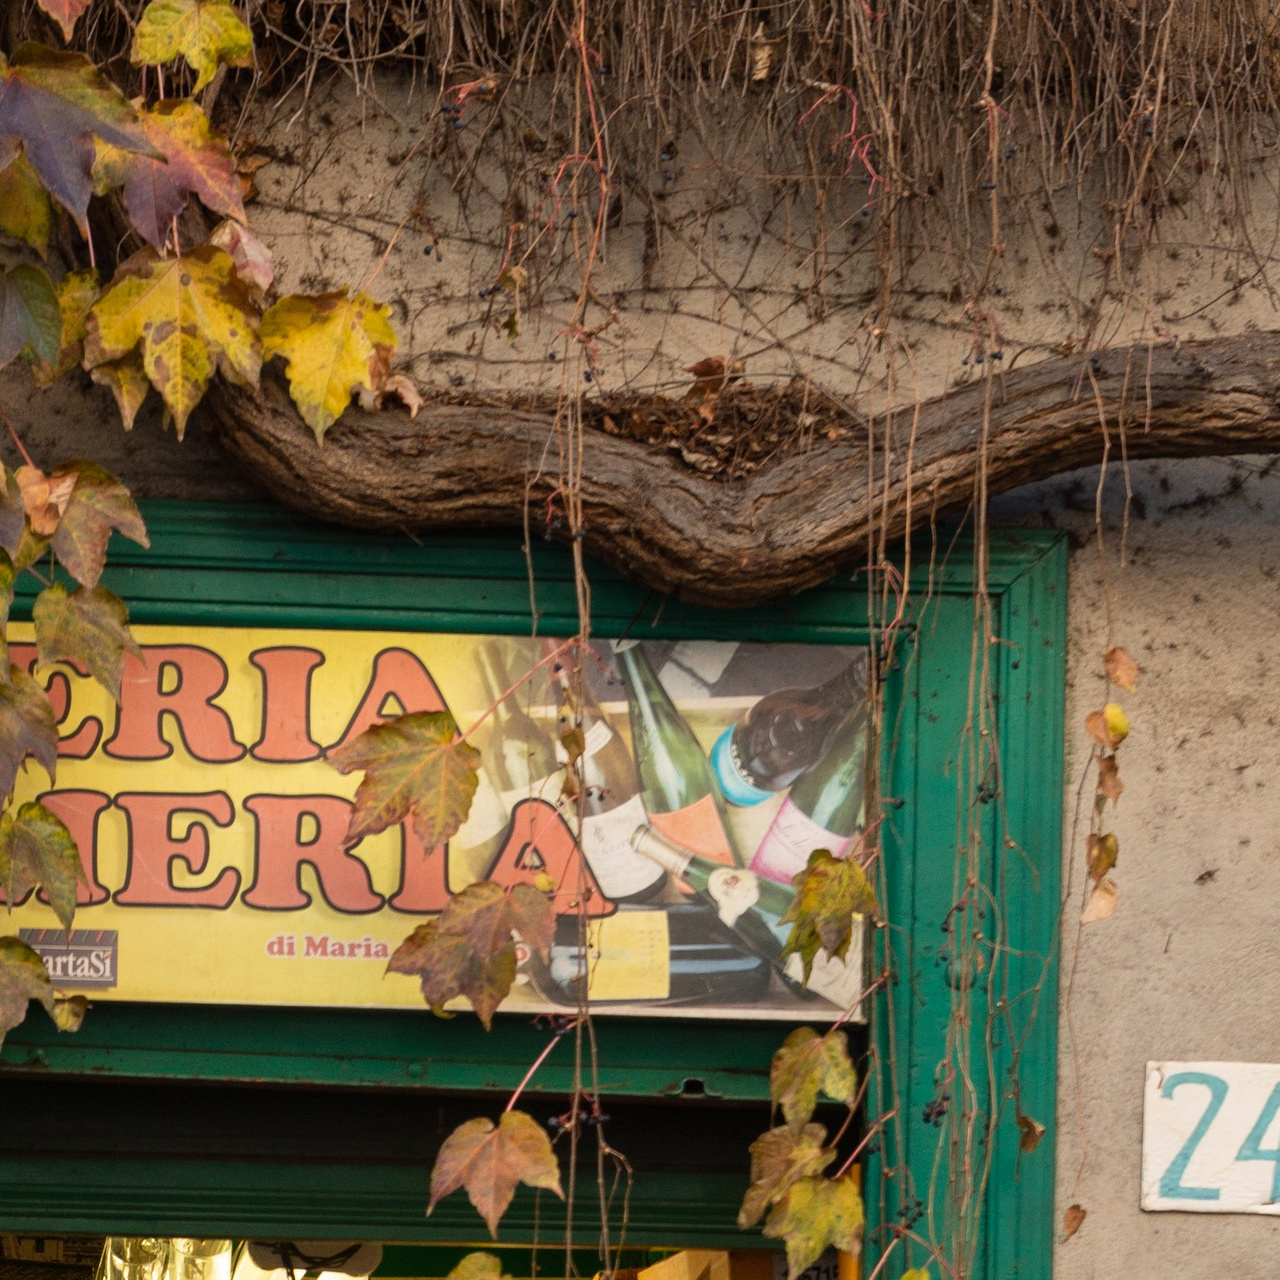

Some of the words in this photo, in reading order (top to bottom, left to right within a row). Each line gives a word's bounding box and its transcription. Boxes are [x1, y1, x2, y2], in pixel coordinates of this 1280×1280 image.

[38, 947, 113, 979] artaSì
[267, 936, 295, 958] di
[304, 936, 390, 960] Maria
[1157, 1070, 1280, 1204] 24
